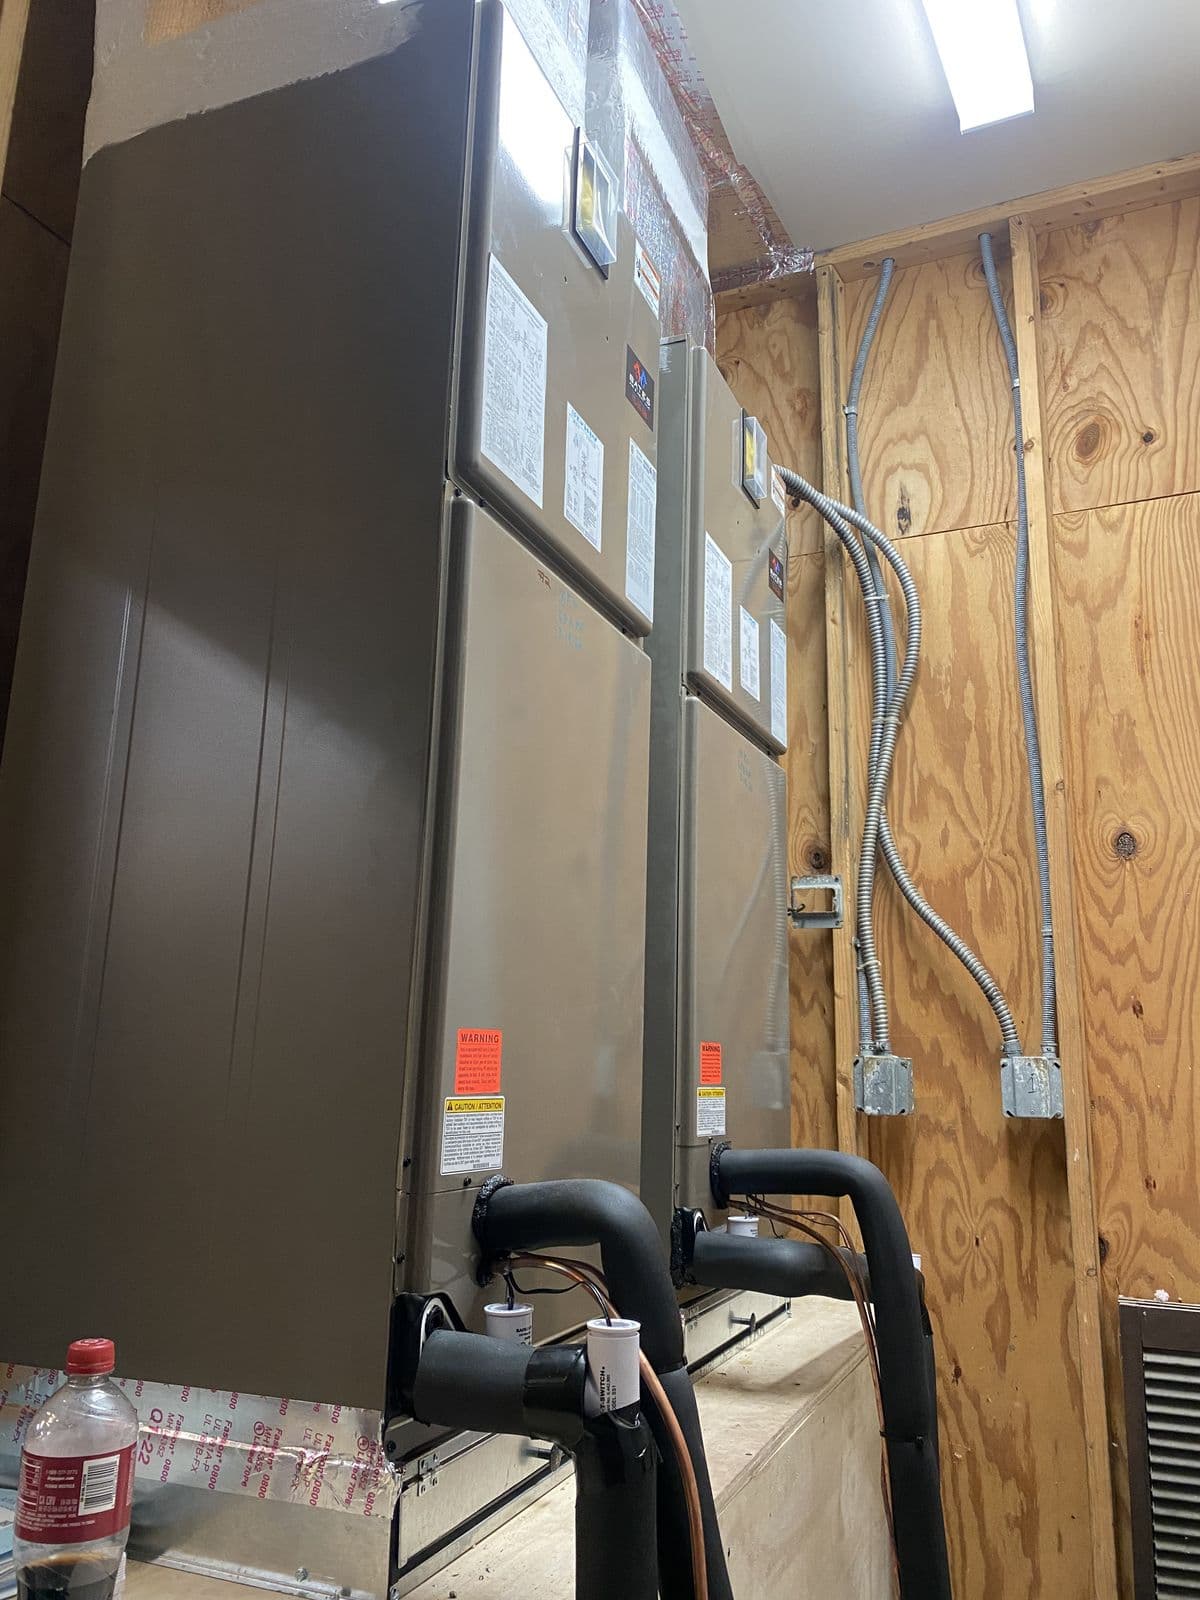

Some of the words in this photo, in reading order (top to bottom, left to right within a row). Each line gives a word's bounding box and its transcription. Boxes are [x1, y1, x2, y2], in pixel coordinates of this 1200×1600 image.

[461, 1033, 499, 1044] WARNING
[454, 1102, 475, 1111] CAUTION
[479, 1102, 502, 1110] ATTENTION
[203, 1413, 213, 1426] UL
[213, 1418, 222, 1431] UL
[303, 1427, 313, 1441] UL
[313, 1432, 323, 1447] UL
[247, 1435, 260, 1464] Lied
[160, 1458, 172, 1483] 0800
[208, 1464, 221, 1490] 0800
[350, 1451, 365, 1481] Lised
[258, 1473, 270, 1499] 0800
[309, 1479, 322, 1506] 0800
[363, 1491, 376, 1517] 0800
